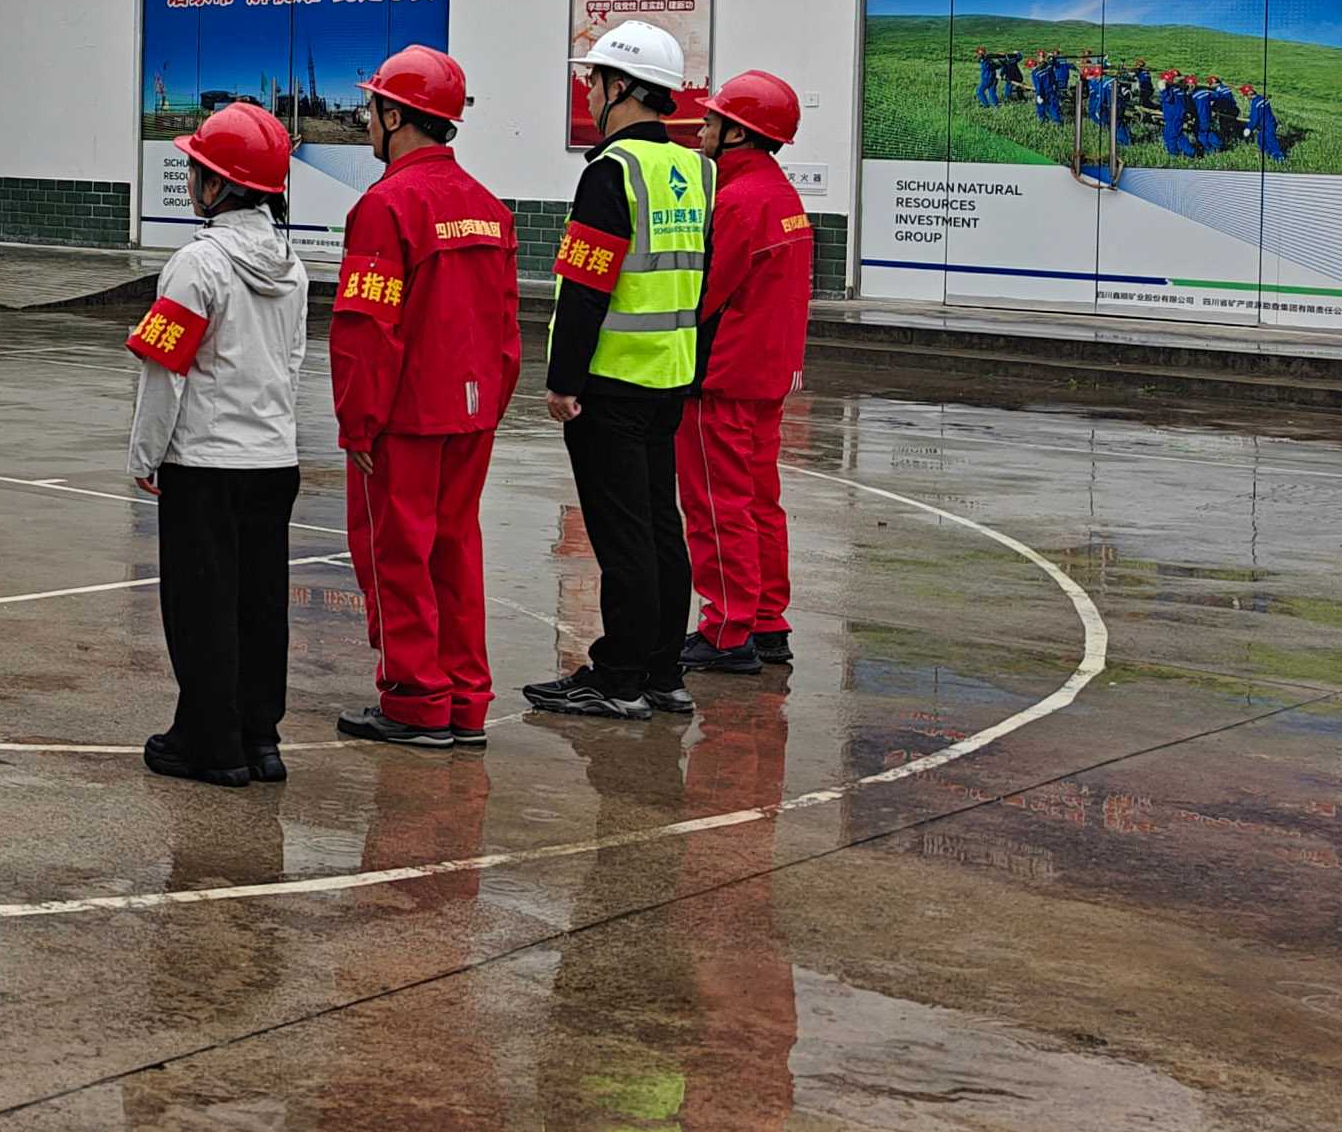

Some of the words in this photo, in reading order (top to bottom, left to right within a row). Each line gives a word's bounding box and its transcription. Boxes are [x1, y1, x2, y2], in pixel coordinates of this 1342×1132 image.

[896, 180, 955, 193] SICHUAN
[957, 182, 1023, 196] NATURAL
[896, 197, 976, 211] RESOURCES
[895, 214, 980, 228] INVESTMENT
[895, 230, 942, 243] GROUP
[343, 272, 403, 307] 总指挥
